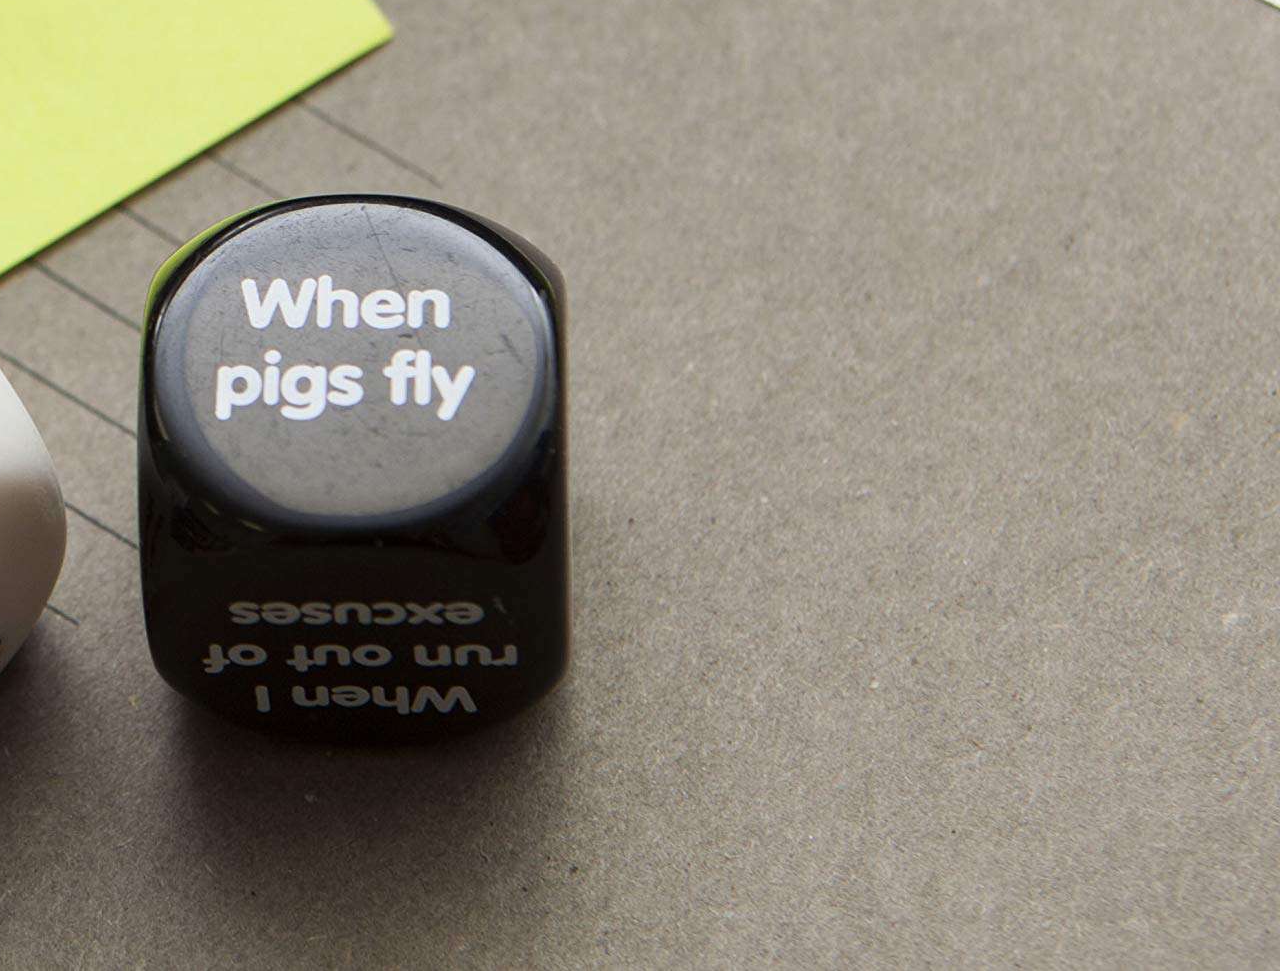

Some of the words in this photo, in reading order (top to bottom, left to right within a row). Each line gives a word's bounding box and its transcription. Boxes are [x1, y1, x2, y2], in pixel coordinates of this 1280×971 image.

[241, 275, 450, 329] When
[215, 350, 364, 420] pigs
[383, 349, 475, 420] fly
[228, 601, 484, 625] excuses
[203, 645, 267, 673] of
[287, 645, 392, 672] out
[414, 645, 517, 667] run
[256, 686, 271, 711] I
[291, 686, 478, 714] When
